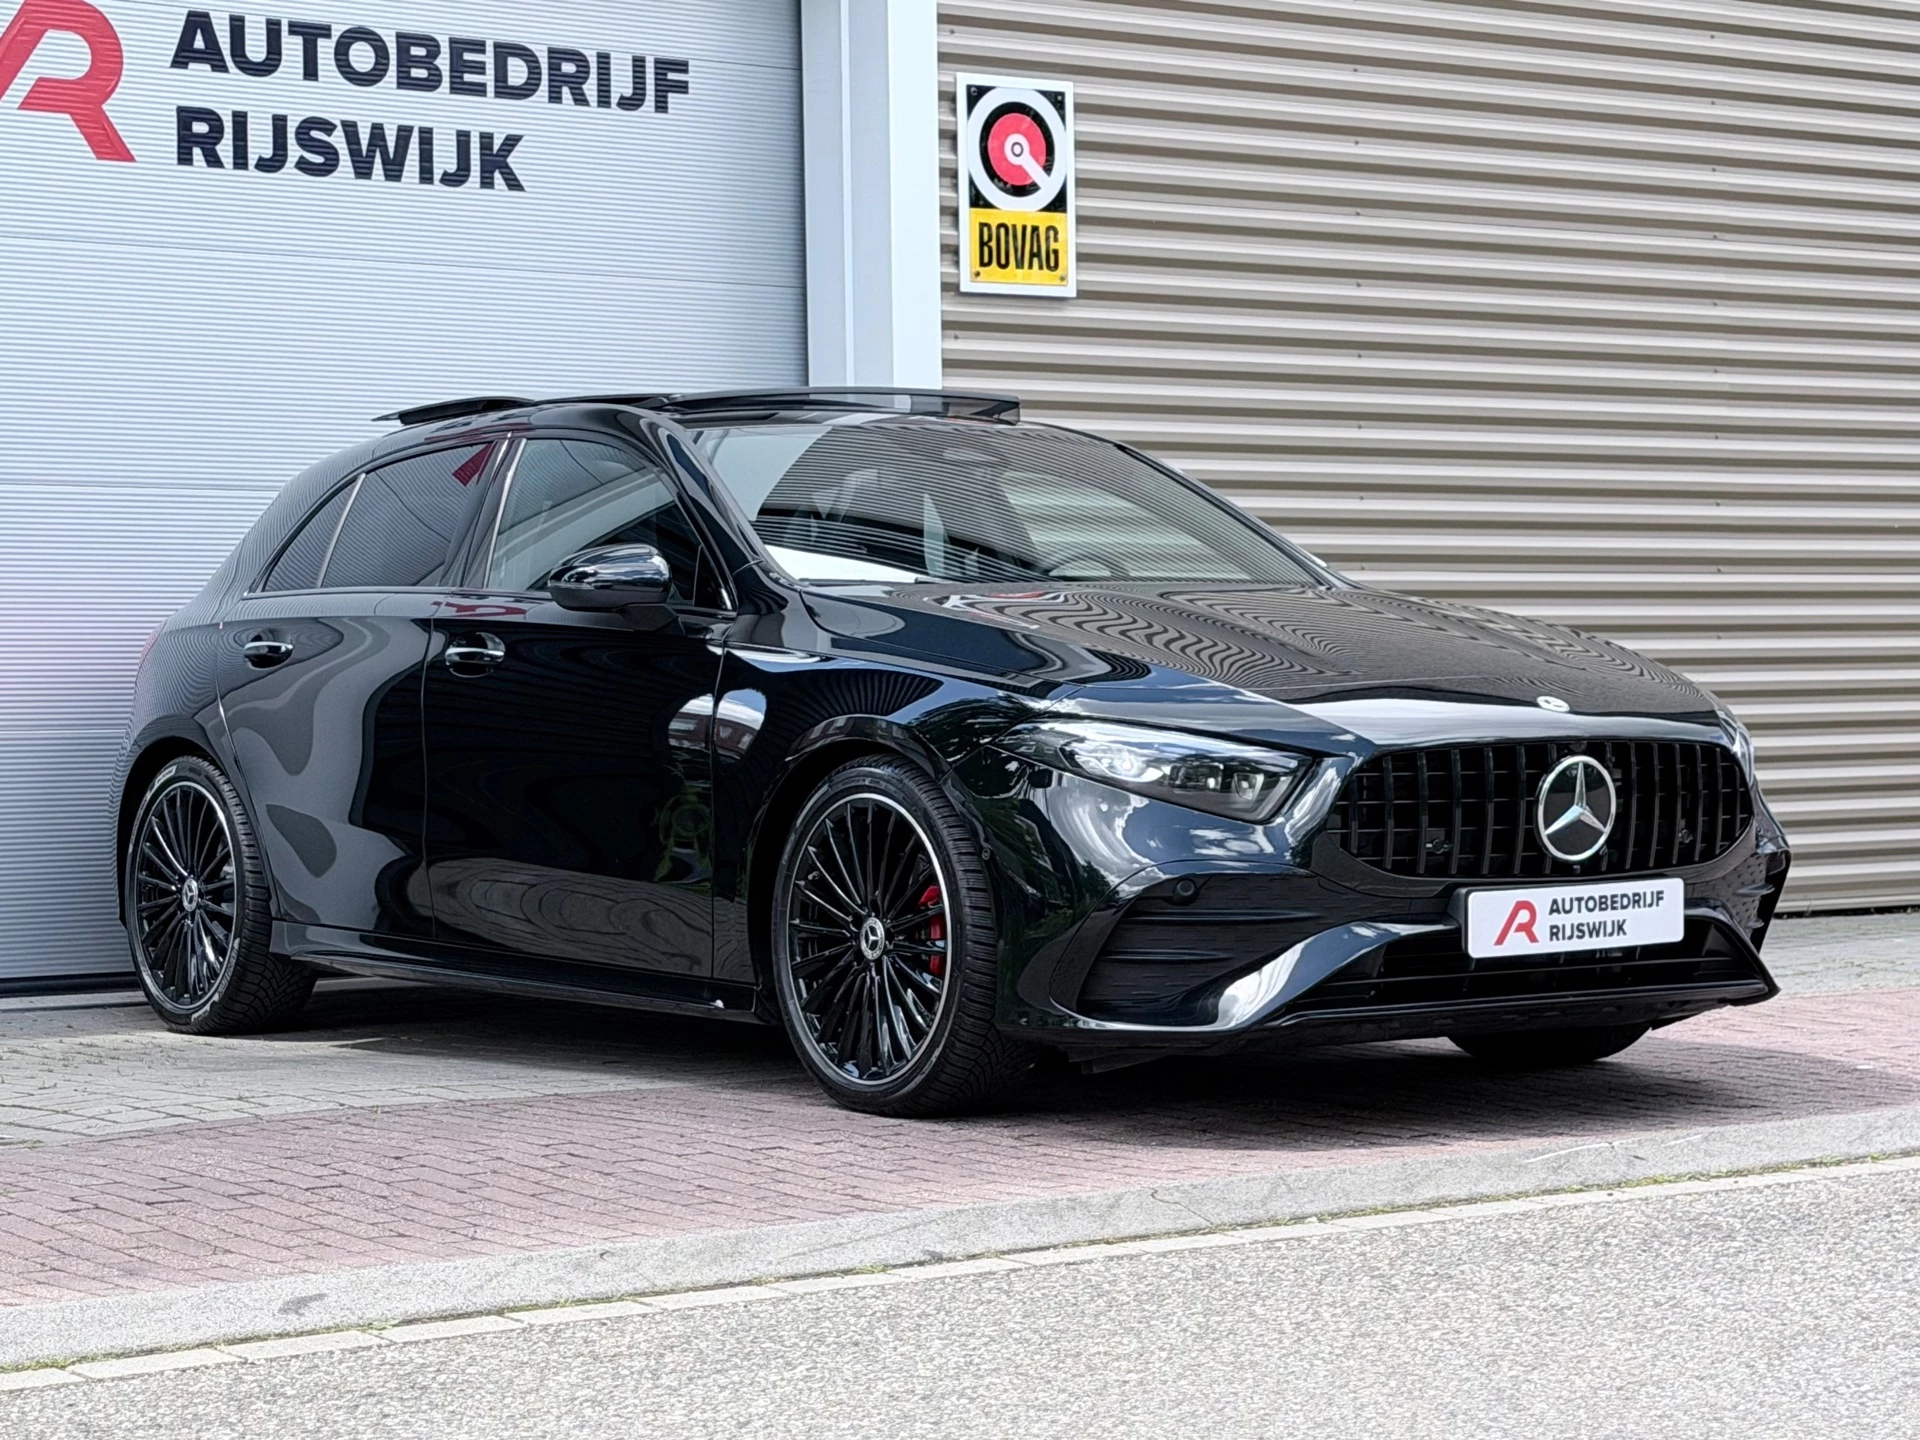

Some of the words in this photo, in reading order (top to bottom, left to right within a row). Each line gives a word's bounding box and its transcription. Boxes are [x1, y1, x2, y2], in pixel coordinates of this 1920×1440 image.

[170, 10, 689, 114] AUTOBEDRIJF
[175, 105, 526, 192] RIJSWIJK
[978, 221, 1060, 272] BOVAG
[1548, 890, 1665, 916] AUTOBEDRIJF
[1549, 919, 1628, 942] RIJSWIJK
